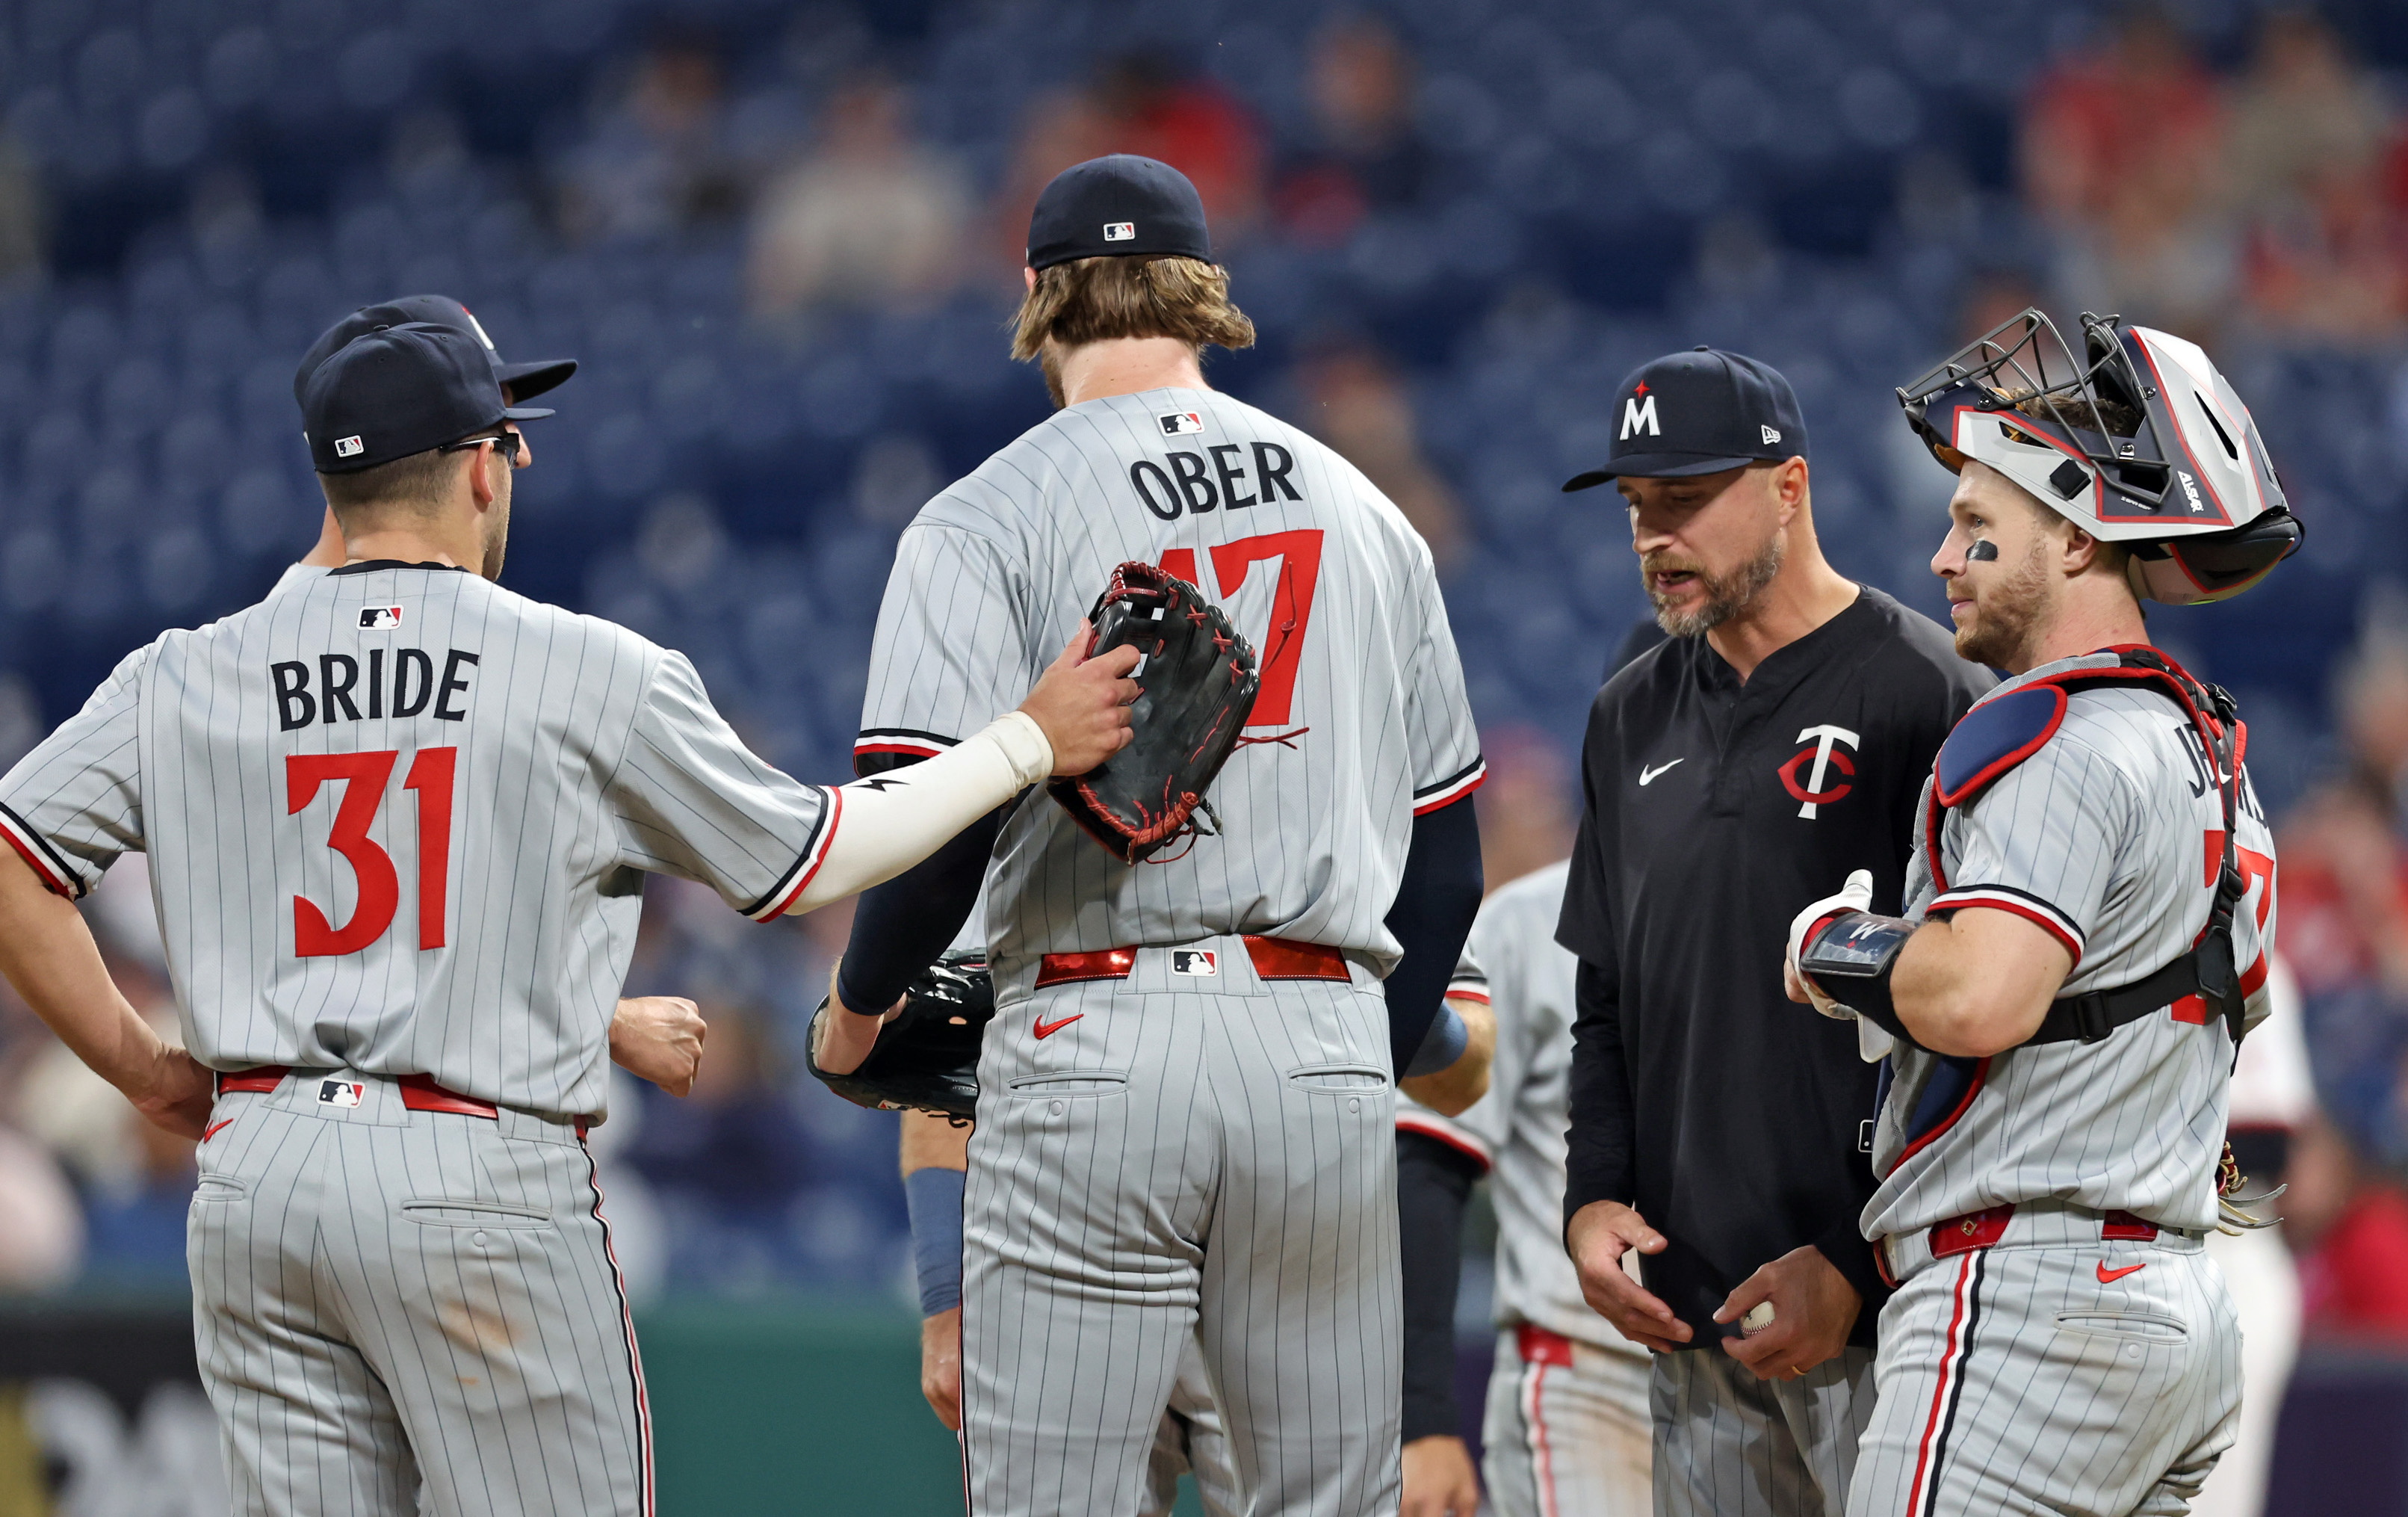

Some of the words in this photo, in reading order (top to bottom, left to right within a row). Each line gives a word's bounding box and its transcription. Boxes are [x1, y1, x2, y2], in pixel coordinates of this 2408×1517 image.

[1619, 395, 1661, 441] M
[1130, 442, 1304, 521] OBER
[270, 647, 480, 732] BRIDE
[285, 746, 457, 958] 31
